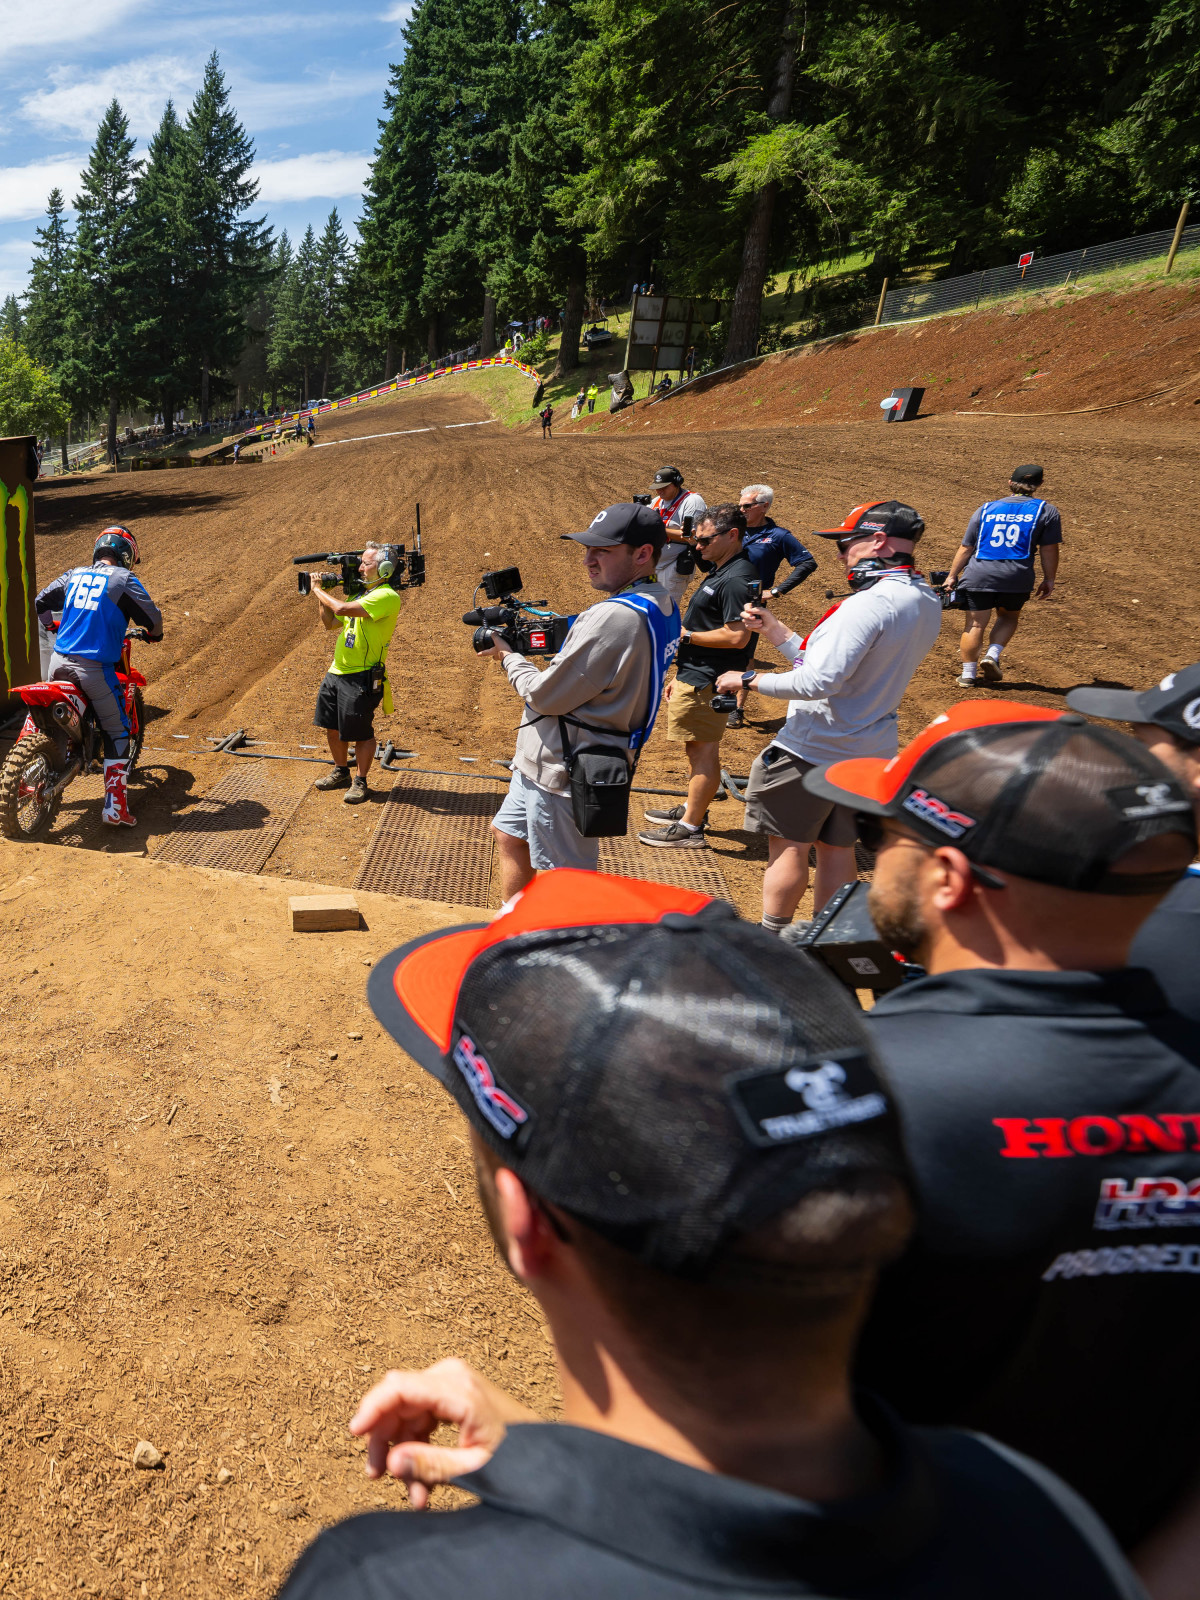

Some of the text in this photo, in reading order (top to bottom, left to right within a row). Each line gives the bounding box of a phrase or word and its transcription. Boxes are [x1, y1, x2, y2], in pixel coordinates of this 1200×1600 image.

[985, 513, 1034, 523] PRESS
[989, 523, 1020, 548] 59
[65, 574, 107, 611] 762
[991, 1113, 1200, 1158] HON
[1092, 1176, 1200, 1230] HR
